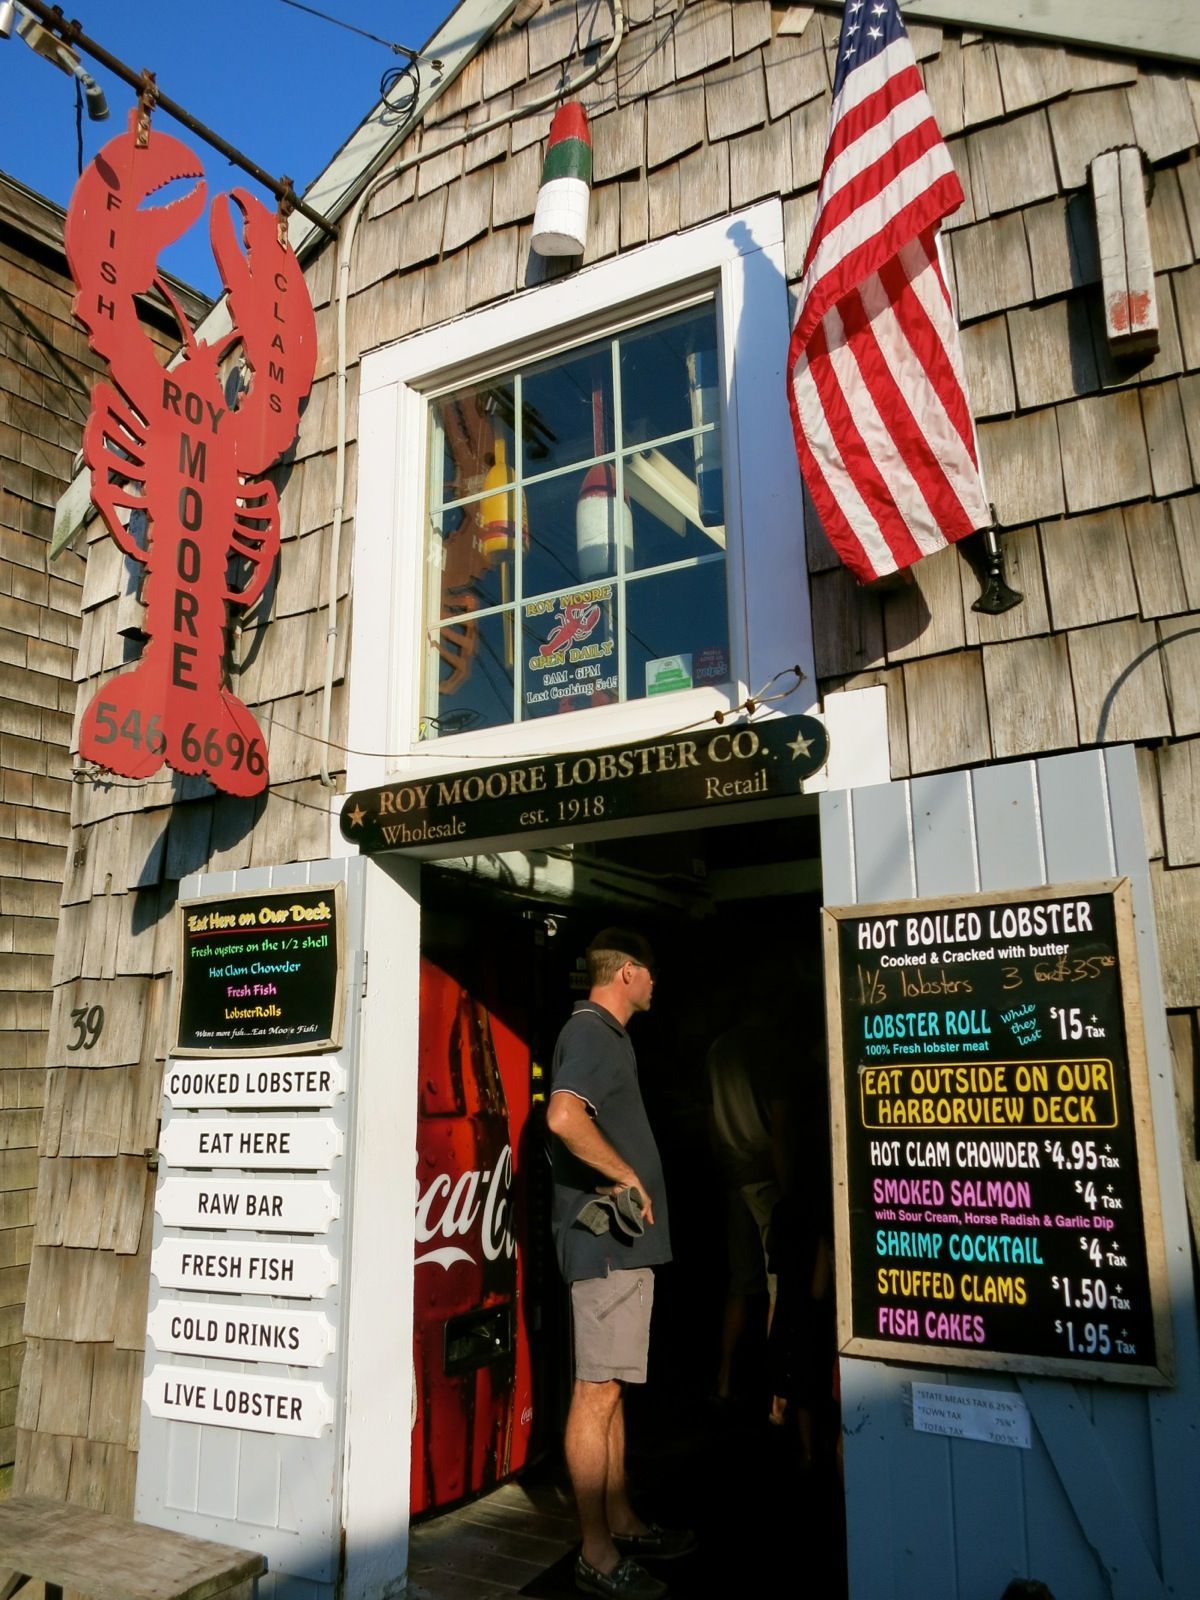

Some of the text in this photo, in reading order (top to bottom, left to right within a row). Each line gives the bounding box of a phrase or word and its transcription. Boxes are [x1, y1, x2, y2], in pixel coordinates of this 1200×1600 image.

[97, 192, 122, 321] FISH
[268, 273, 288, 414] CLAMS
[162, 379, 225, 692] ROY MOORE
[526, 585, 612, 617] ROY MOORE
[529, 640, 614, 670] OPEN DAILY
[543, 671, 568, 686] 9AM
[575, 664, 600, 679] 6PM
[527, 692, 549, 703] Last
[550, 683, 593, 698] Cooking
[95, 701, 264, 776] 546 6696
[380, 731, 769, 815] ROY MOORE LOBSTER CO.
[382, 769, 768, 845] Wholesale est. 1918 Retail
[188, 901, 332, 932] Eat Here on Our Deck
[858, 901, 1093, 950] HOT BOILED LOBSTER
[191, 935, 328, 958] Fresh oysters on the 1/2 shell
[881, 943, 1069, 967] Cooked & Cracked with butter
[209, 961, 301, 978] Hot Clam Chowder
[901, 968, 973, 997] lobsters
[1001, 967, 1023, 989] 3
[227, 983, 277, 997] Fresh Fish
[66, 1004, 105, 1050] 39
[864, 1012, 940, 1039] LOBSTER
[945, 1009, 991, 1036] ROLL
[1085, 1026, 1106, 1038] Tax
[1000, 1003, 1036, 1023] While
[1010, 1018, 1037, 1035] they
[268, 1026, 294, 1035] Mooe
[1018, 1029, 1042, 1046] last
[865, 1040, 989, 1055] 100% Fresh lobster meat
[170, 1071, 331, 1095] COOKED LOBSTER
[865, 1064, 1109, 1095] EAT OUTSIDE ON OUR
[879, 1096, 1097, 1124] HARBORVIEW DECK
[199, 1133, 291, 1154] EAT HERE
[870, 1141, 901, 1167] HOT
[906, 1141, 950, 1167] CLAM
[956, 1141, 1040, 1168] CHOWDER
[1099, 1155, 1120, 1168] Tax
[197, 1193, 283, 1217] RAW BAR
[873, 1178, 944, 1206] SMOKED
[951, 1180, 1031, 1208] SALMON
[1101, 1196, 1123, 1209] Tax
[875, 1209, 1114, 1231] with Sour Cream, Horse Radish & Garlic Dip
[876, 1229, 943, 1259] SHRIMP
[949, 1233, 1044, 1265] COCKTAIL
[1106, 1253, 1127, 1266] Tax
[181, 1254, 294, 1281] FRESH FISH
[878, 1268, 955, 1300] STUFFED
[961, 1274, 1027, 1305] CLAMS
[1110, 1296, 1131, 1310] Tax
[171, 1316, 300, 1350] COLD DRINKS
[879, 1307, 919, 1336] FISH
[925, 1311, 986, 1343] CAKES
[1115, 1340, 1136, 1354] Tax
[164, 1382, 302, 1421] LIVE LOBSTER
